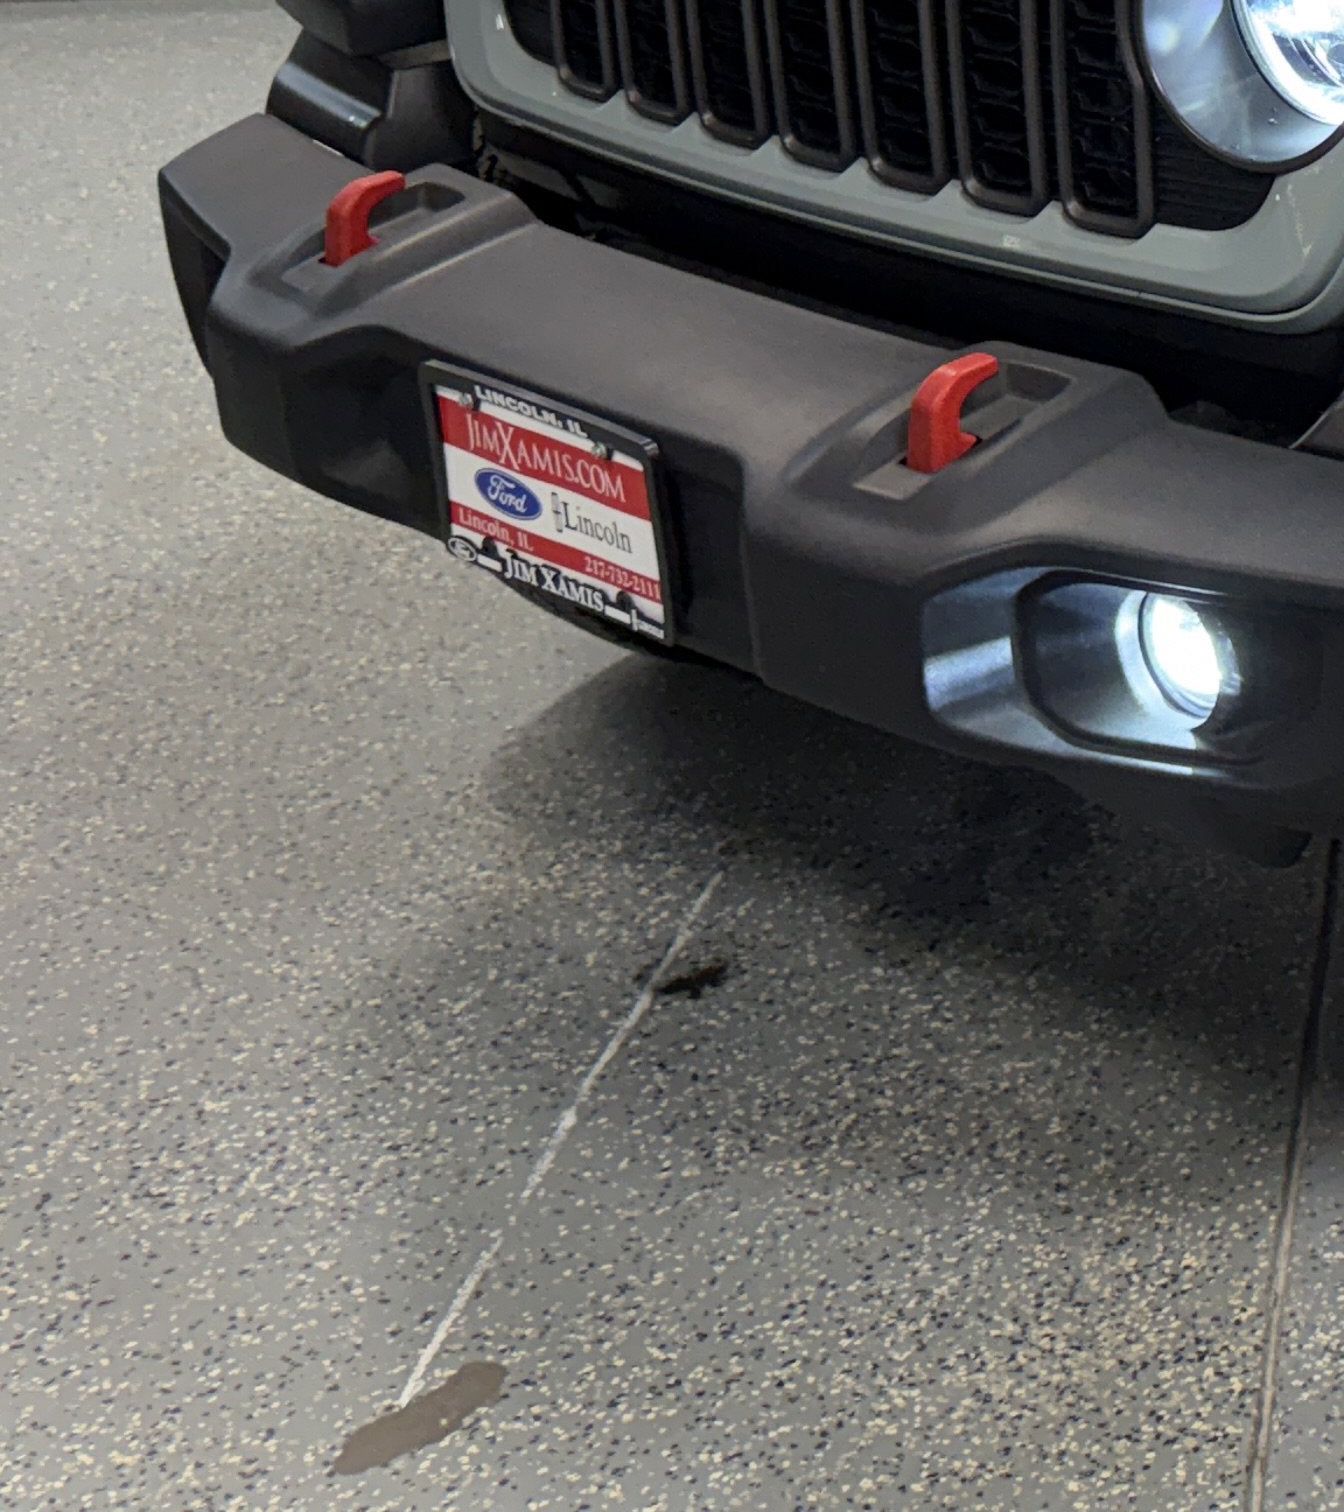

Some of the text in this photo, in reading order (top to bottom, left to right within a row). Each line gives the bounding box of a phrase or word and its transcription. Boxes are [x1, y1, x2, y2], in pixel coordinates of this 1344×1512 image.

[474, 385, 588, 438] LINCOLN, IL
[466, 413, 626, 503] JIMXAMIS.COM
[459, 507, 534, 551] Lincoln, IL
[487, 475, 633, 554] Ford Lincoln
[503, 552, 605, 612] JIM XAMIS
